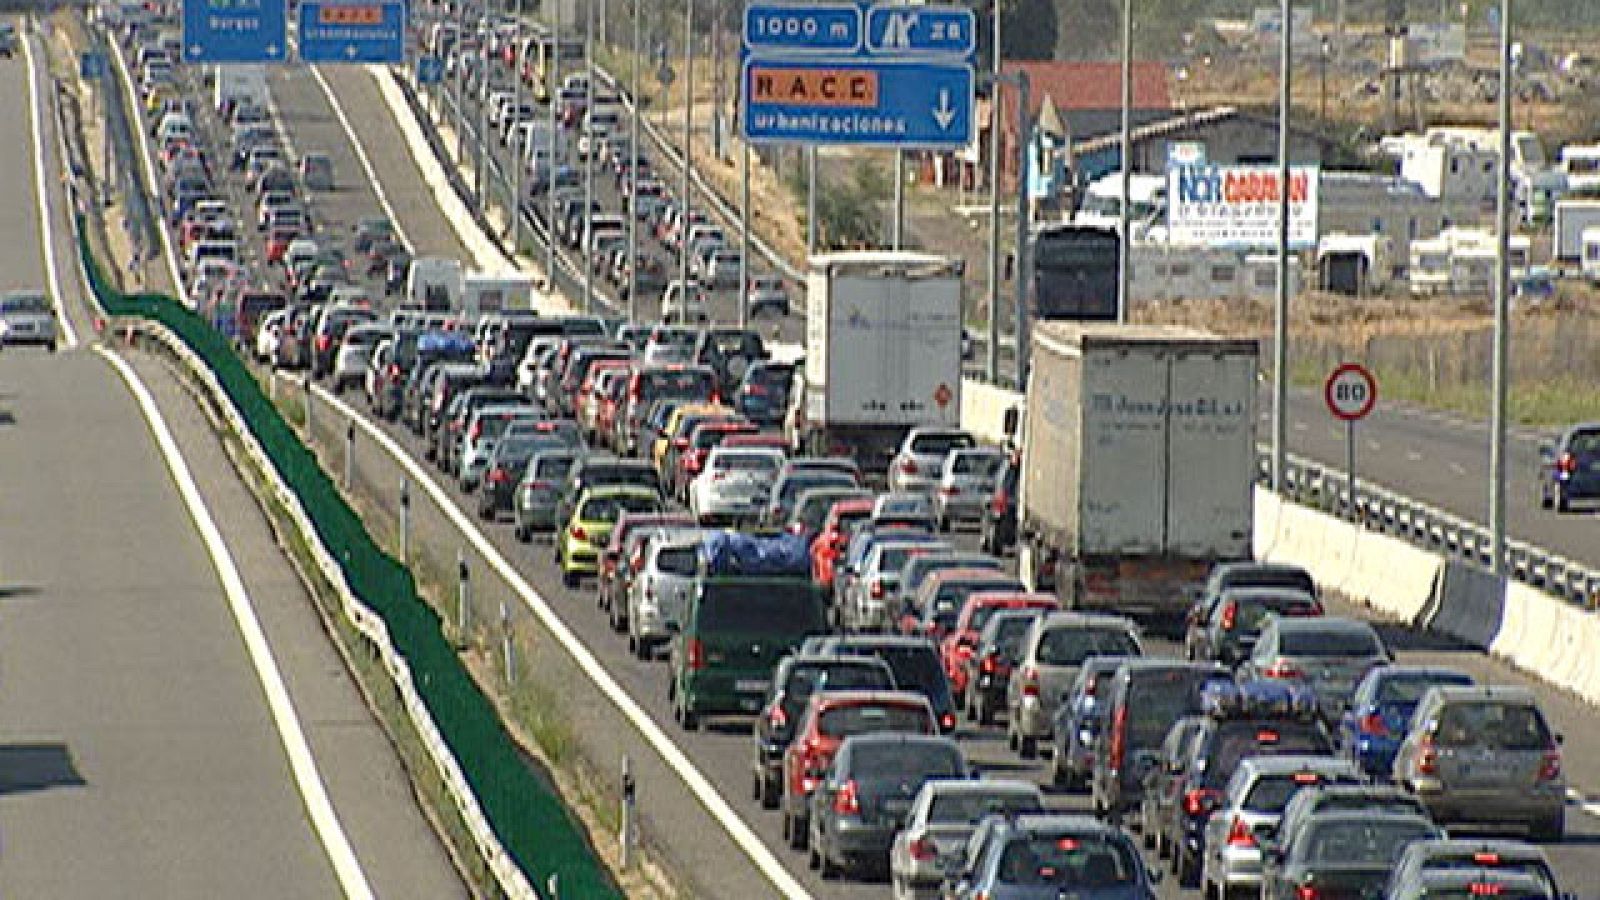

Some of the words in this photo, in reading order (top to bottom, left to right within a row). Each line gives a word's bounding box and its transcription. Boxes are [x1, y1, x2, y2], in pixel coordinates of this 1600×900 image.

[757, 17, 818, 36] 1000
[829, 22, 848, 39] m
[754, 113, 906, 134] urbanizaciones
[1225, 171, 1308, 203] CARAAN
[1336, 383, 1366, 401] 80
